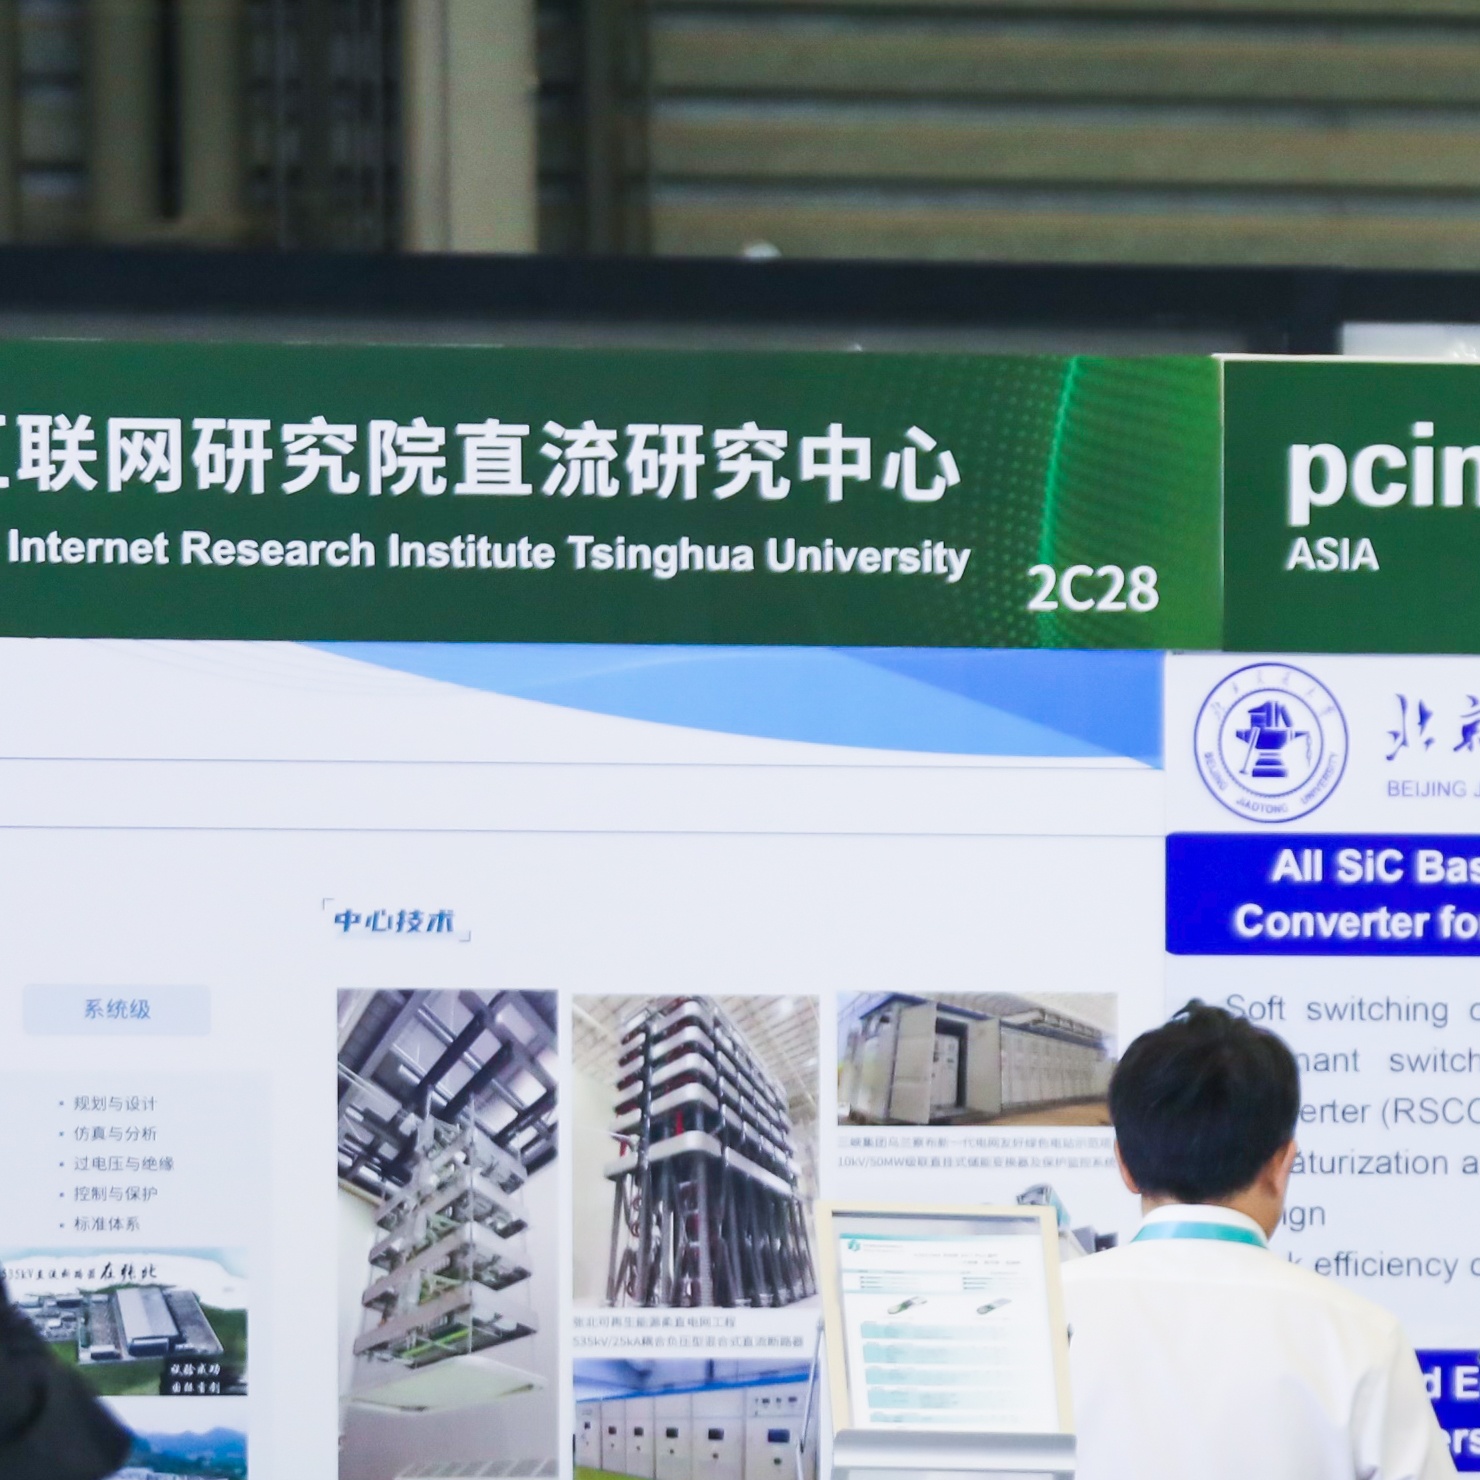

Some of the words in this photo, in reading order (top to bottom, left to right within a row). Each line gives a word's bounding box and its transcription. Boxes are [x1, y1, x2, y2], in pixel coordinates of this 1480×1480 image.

[8, 529, 171, 566] Internet
[181, 531, 377, 569] Research
[388, 533, 557, 571] Institute
[566, 535, 756, 581] Tsinghua
[766, 538, 973, 585] University
[1286, 537, 1381, 573] ASIA
[1027, 564, 1161, 614] 2C28
[1387, 780, 1468, 799] BEIJING
[1271, 849, 1324, 883] All
[1336, 849, 1405, 885] SiC
[333, 908, 456, 935] 中心技术
[1234, 904, 1432, 941] Converter
[82, 997, 152, 1021] 系统级
[1225, 993, 1287, 1023] Soft
[1306, 996, 1449, 1030] switching
[73, 1095, 158, 1112] 规划与设计
[73, 1125, 158, 1142] 仿真与分析
[73, 1155, 175, 1172] 过电压与绝缘
[73, 1185, 159, 1202] 控制与保护
[73, 1215, 141, 1232] 标准体系
[1314, 1248, 1462, 1283] efficiency
